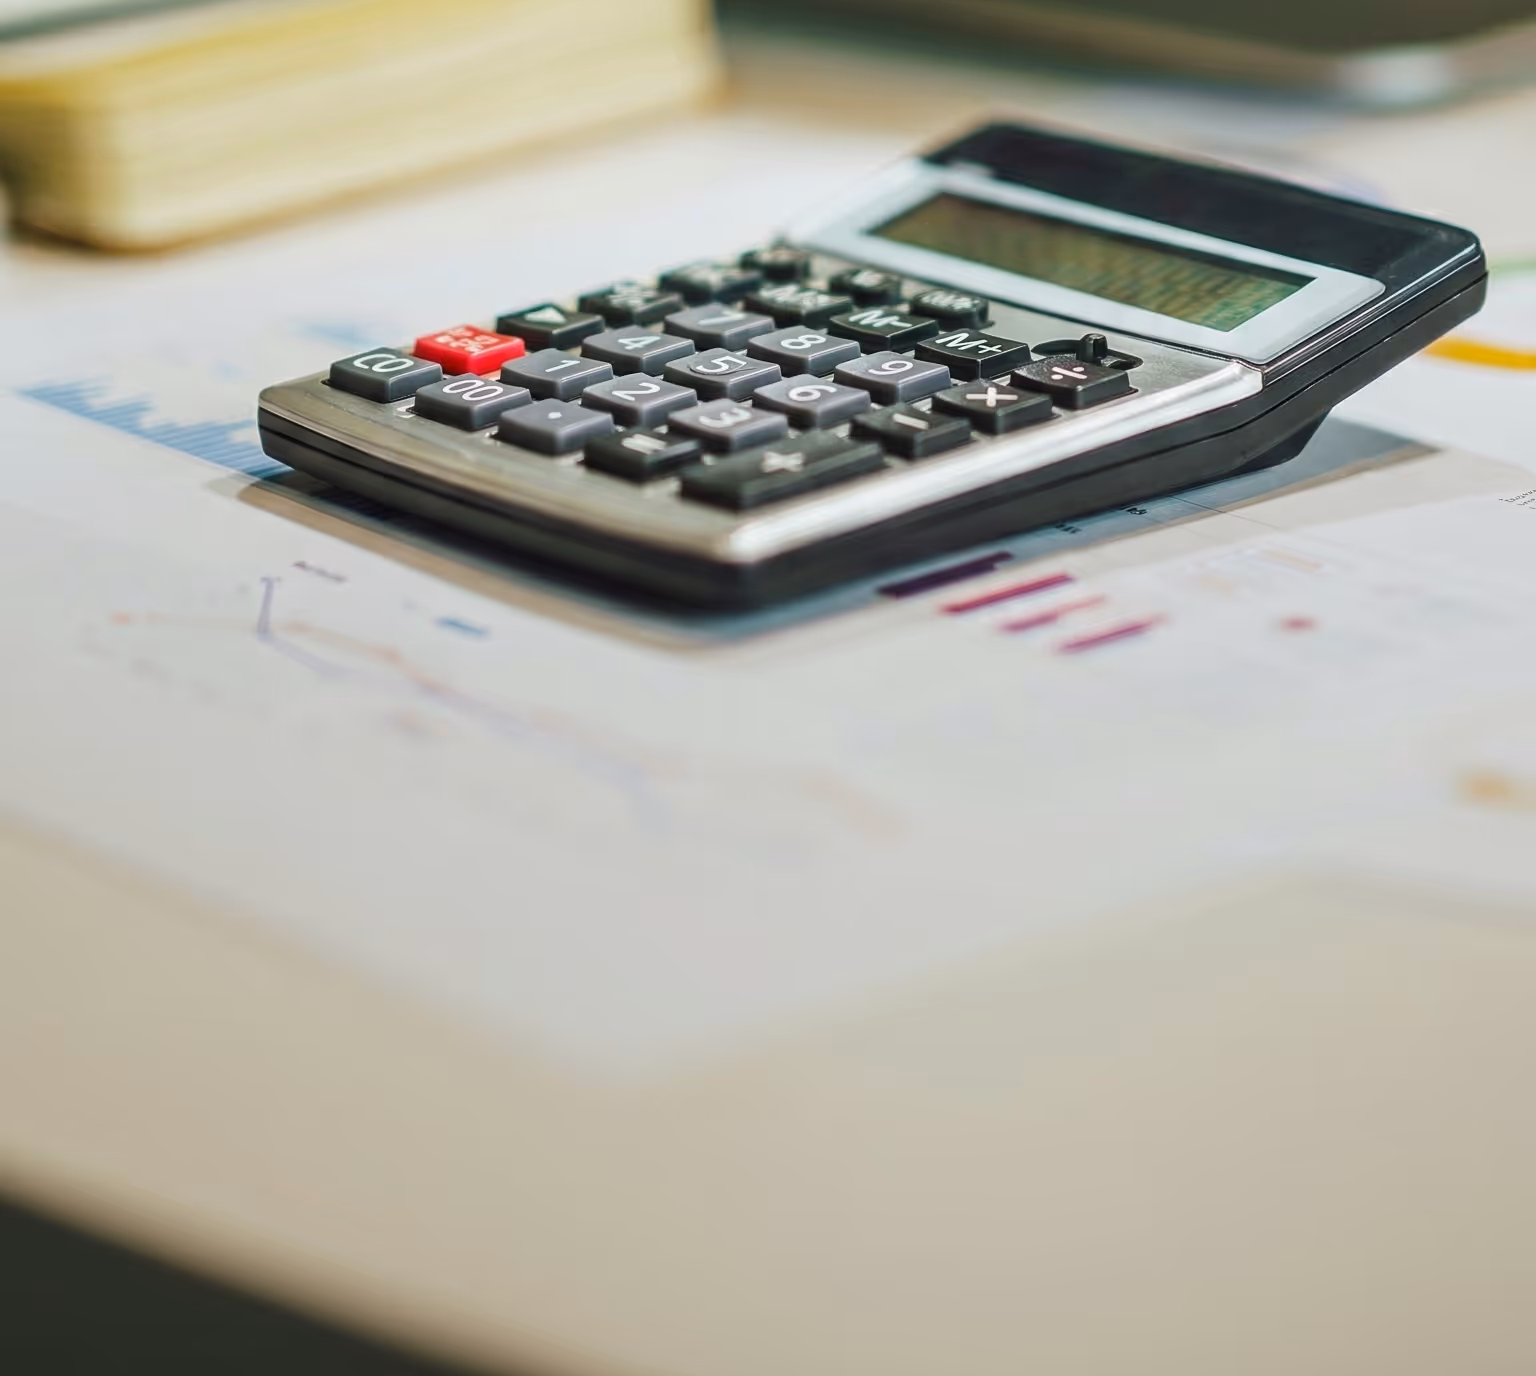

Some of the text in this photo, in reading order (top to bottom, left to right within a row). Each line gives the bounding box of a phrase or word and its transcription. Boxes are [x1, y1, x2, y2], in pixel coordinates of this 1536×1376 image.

[617, 335, 662, 351] 4
[780, 334, 827, 350] 8
[935, 332, 1002, 354] M+
[545, 359, 581, 373] 1
[695, 355, 748, 374] 5
[868, 360, 914, 376] 9
[442, 379, 504, 402] 00
[611, 382, 661, 402] 2
[788, 384, 838, 403] 6
[699, 407, 752, 428] 3
